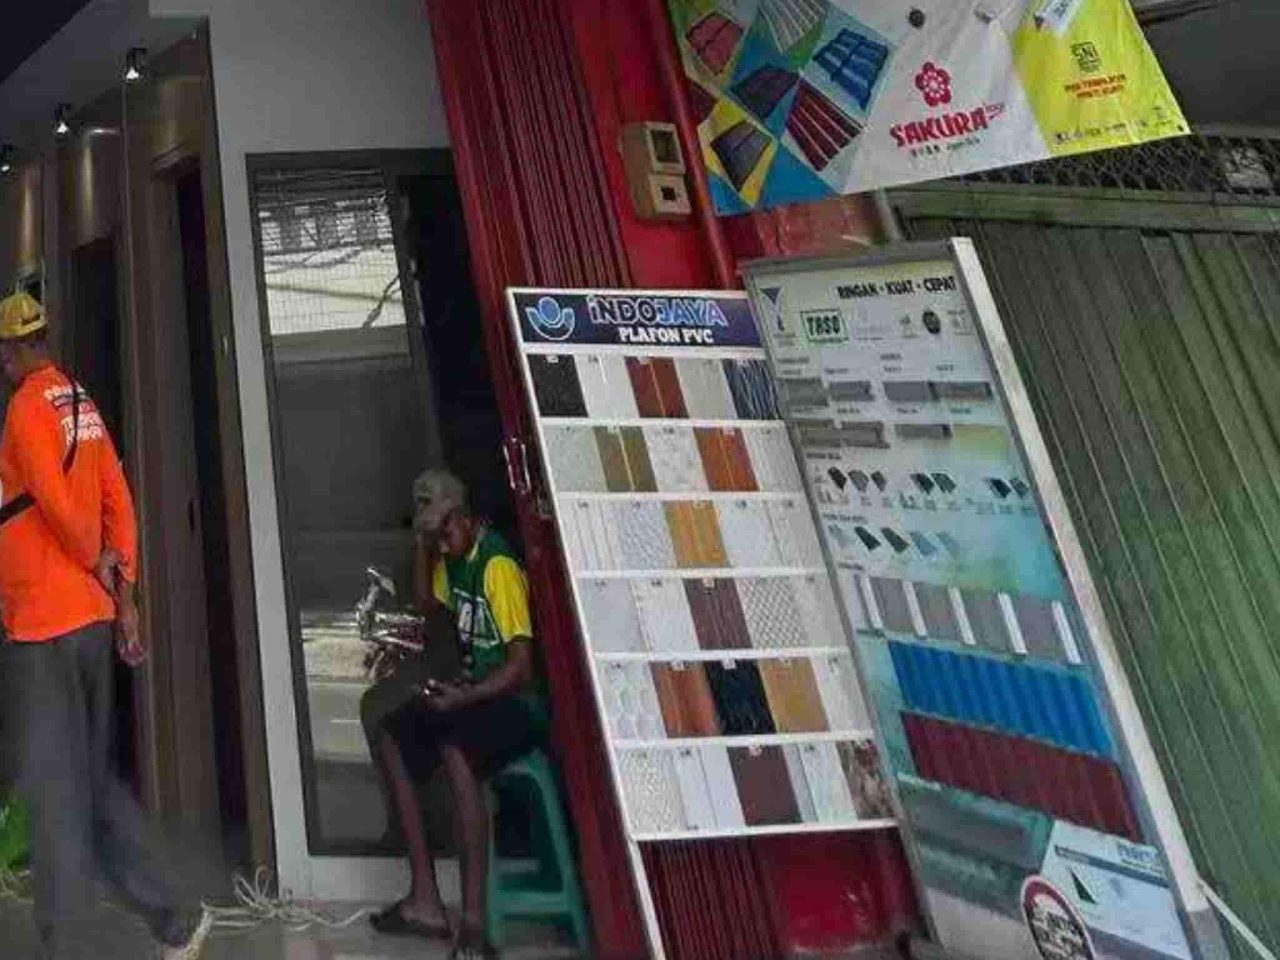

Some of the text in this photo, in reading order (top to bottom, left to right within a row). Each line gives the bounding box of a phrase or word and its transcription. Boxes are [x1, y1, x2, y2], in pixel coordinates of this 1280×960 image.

[889, 107, 989, 147] SAKURA
[923, 274, 958, 292] CEPAT
[619, 326, 716, 344] PLAFON PVC
